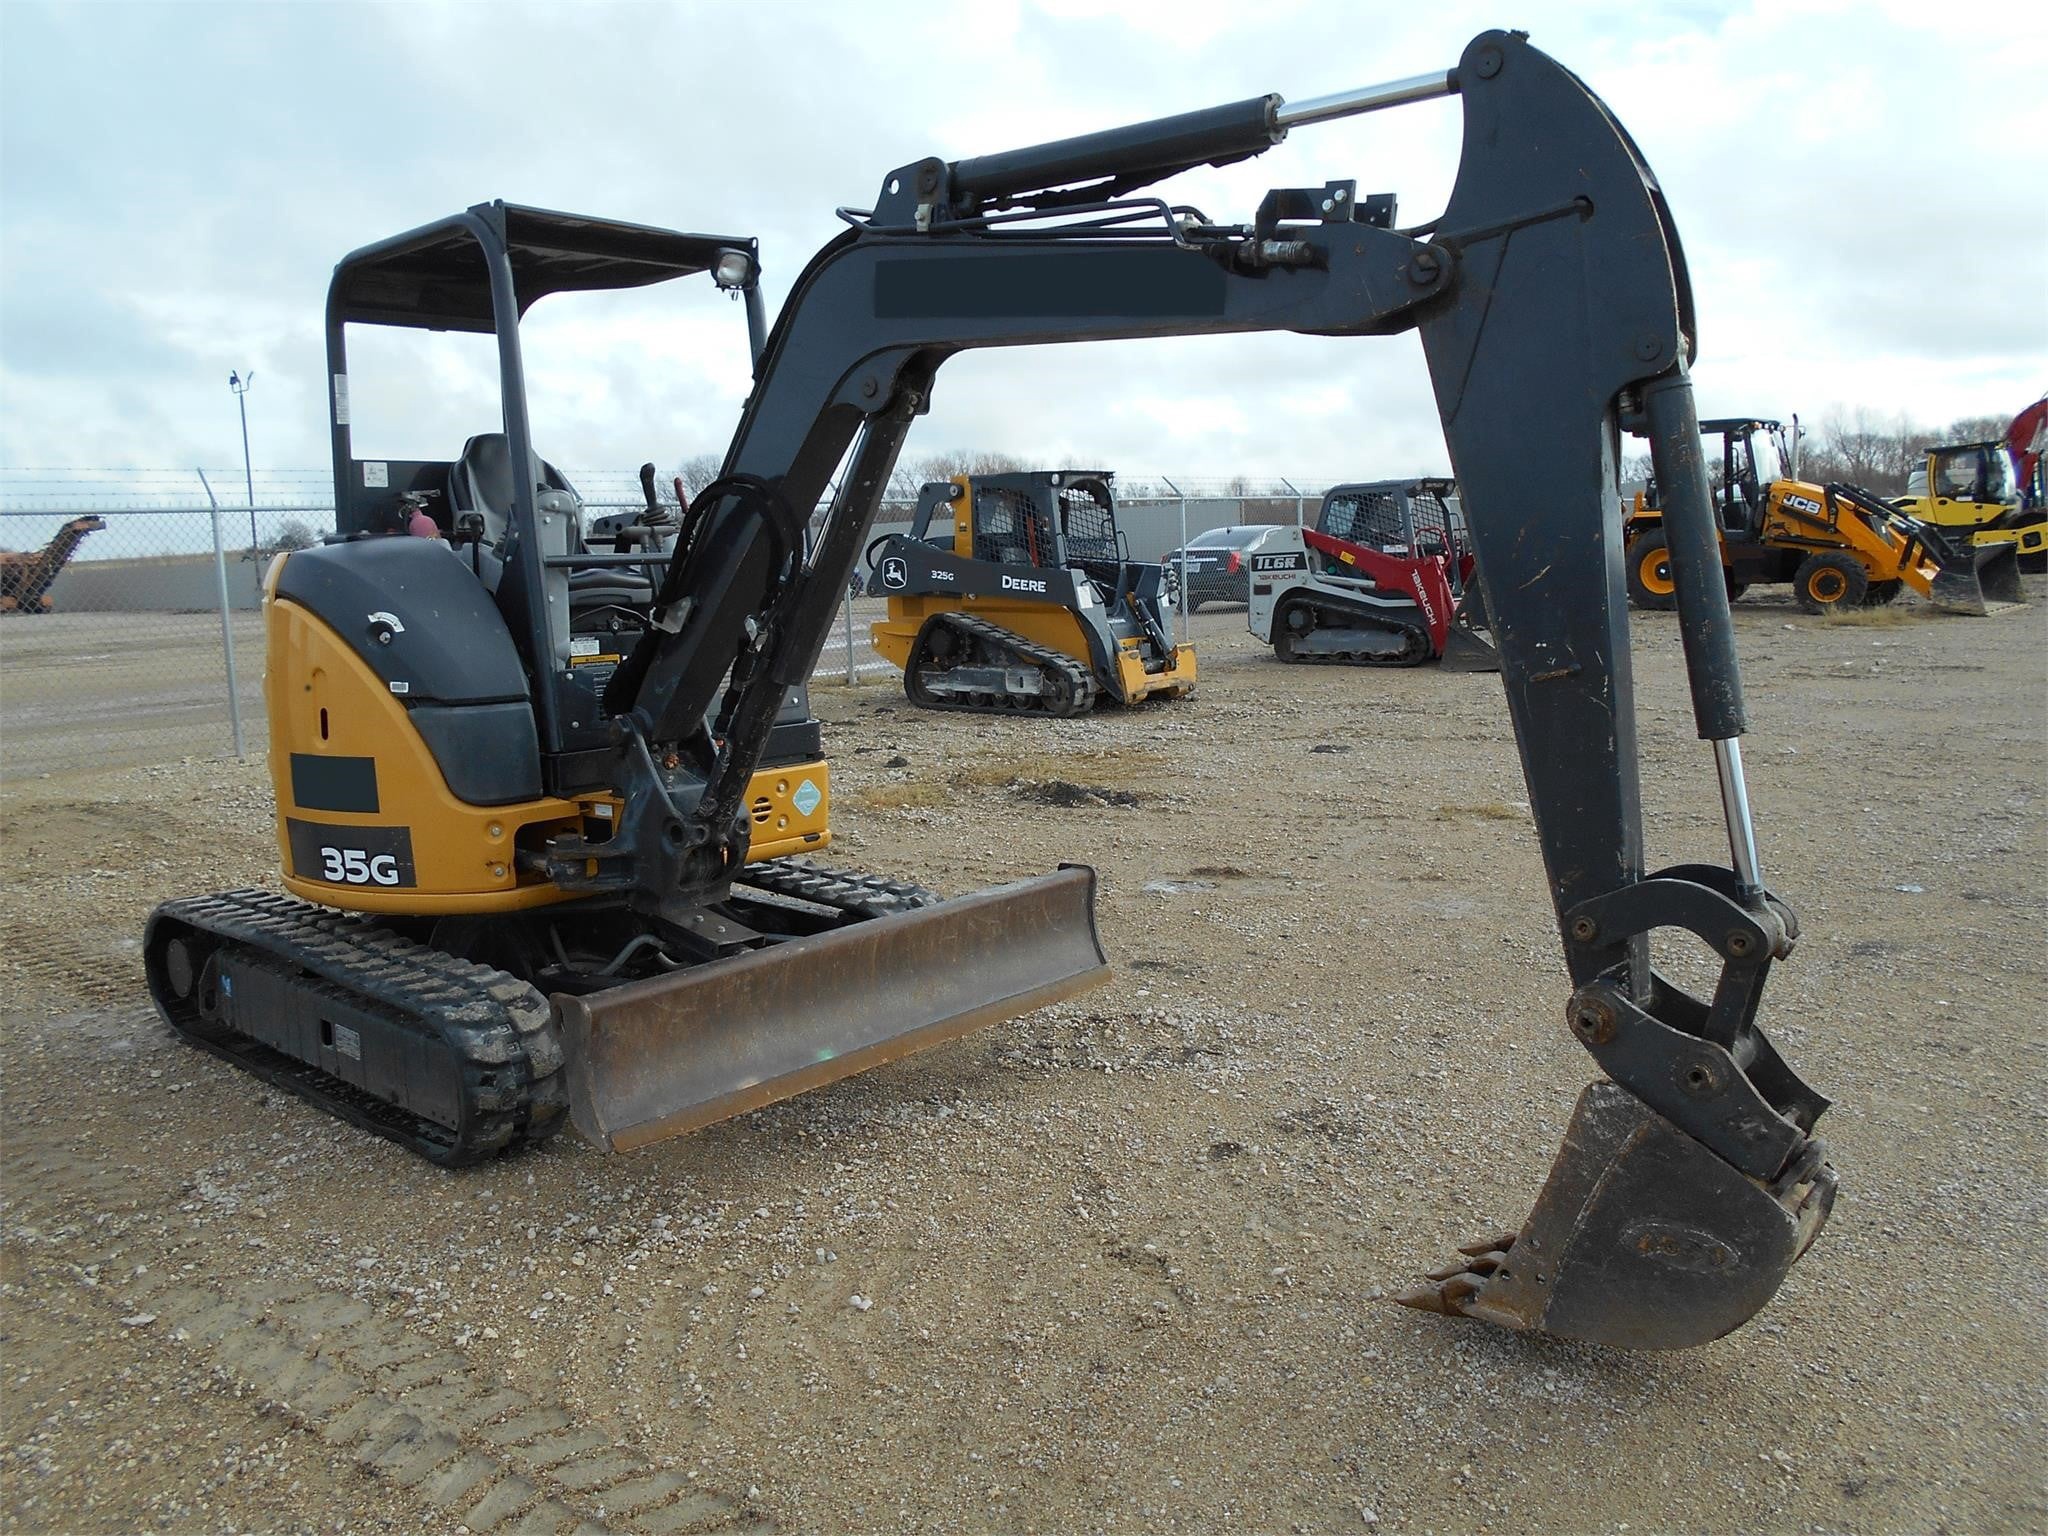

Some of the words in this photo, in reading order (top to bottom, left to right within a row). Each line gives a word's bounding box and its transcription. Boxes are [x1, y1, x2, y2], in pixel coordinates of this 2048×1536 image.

[1782, 493, 1821, 514] JCB
[1255, 554, 1299, 570] TL6R
[931, 570, 955, 581] 325G
[1002, 575, 1047, 593] DEERE
[320, 847, 400, 886] 35G
